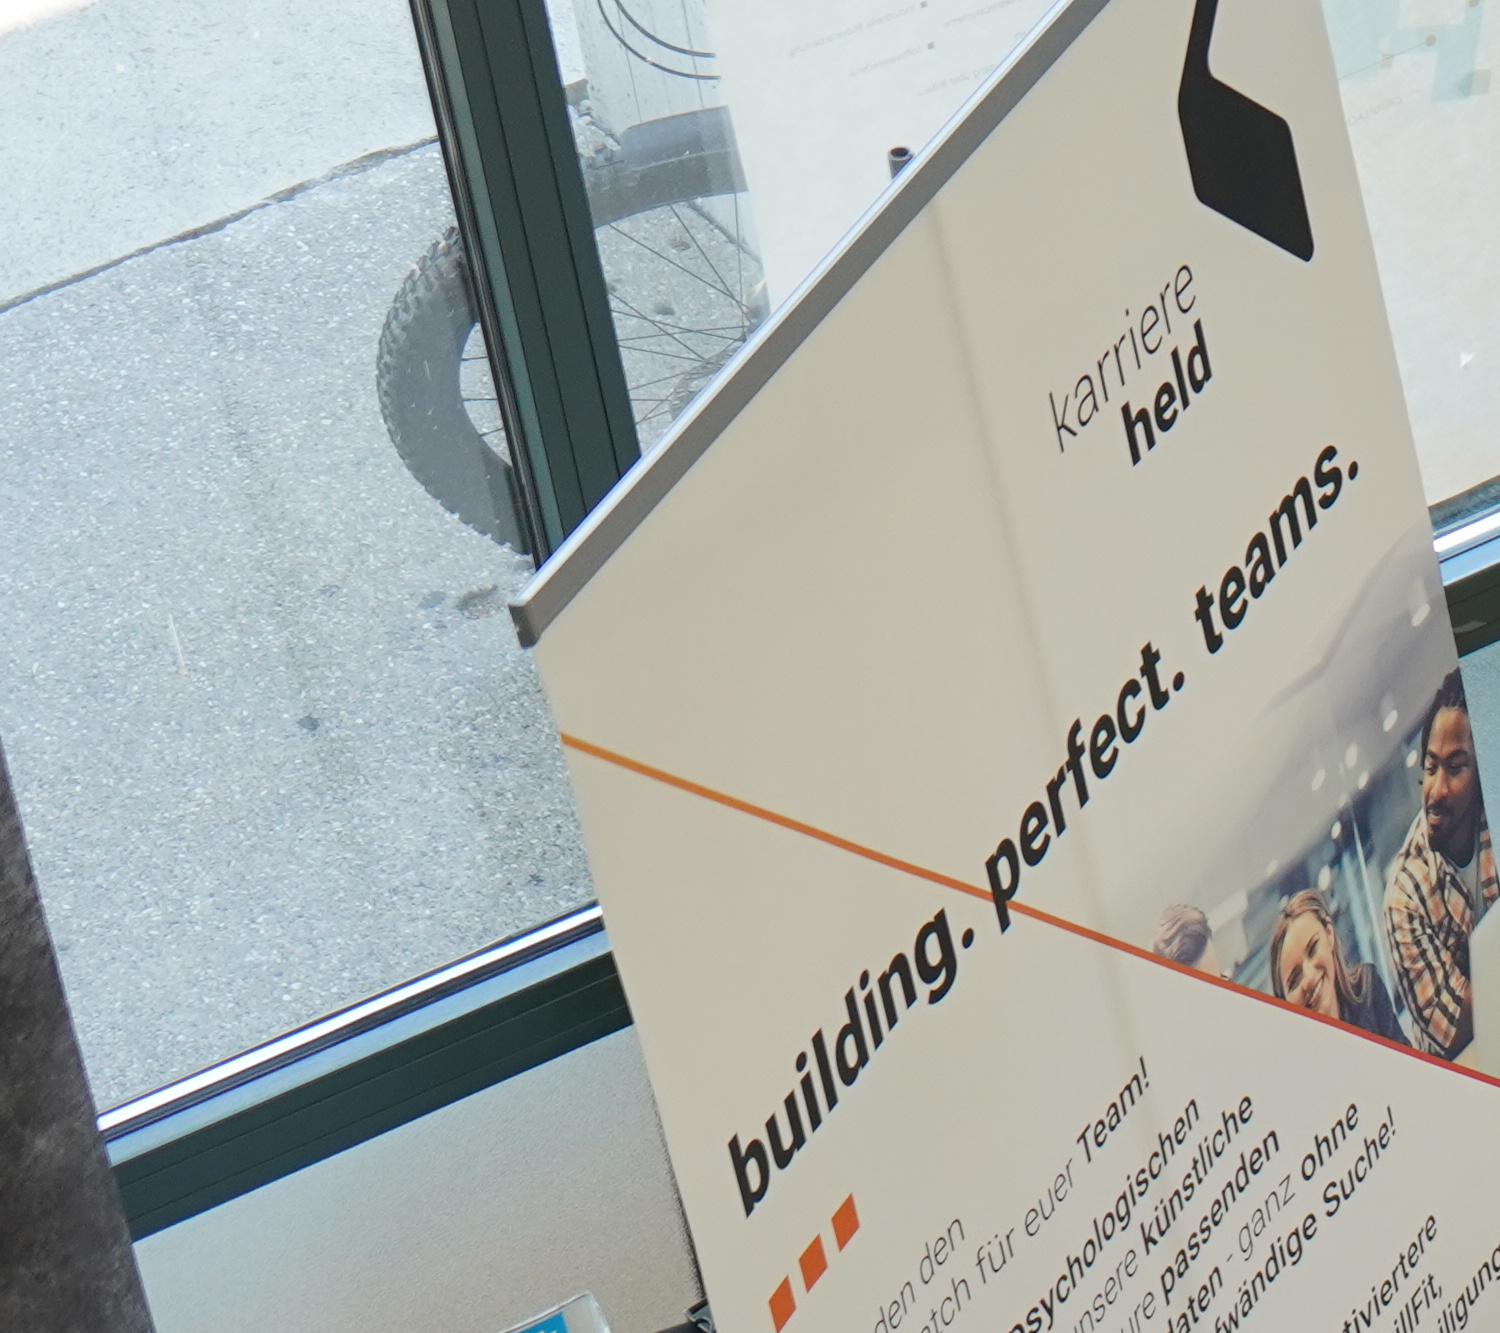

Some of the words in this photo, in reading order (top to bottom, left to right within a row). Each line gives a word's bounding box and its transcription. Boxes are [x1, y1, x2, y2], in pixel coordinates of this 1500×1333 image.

[1046, 258, 1198, 455] karriere
[1120, 319, 1214, 467] held
[726, 904, 974, 1219] building.
[983, 642, 1184, 932] perfect.
[1193, 440, 1360, 656] teams.
[975, 1227, 1015, 1286] für
[1022, 1160, 1075, 1240] euer
[1076, 1055, 1150, 1168] Team!
[1140, 1095, 1254, 1256] künstliche
[1158, 1127, 1281, 1308] passenden
[1236, 1174, 1296, 1265] ganz
[1300, 1101, 1360, 1183] ohne
[1321, 1105, 1397, 1218] Suche!
[917, 1216, 966, 1281] den
